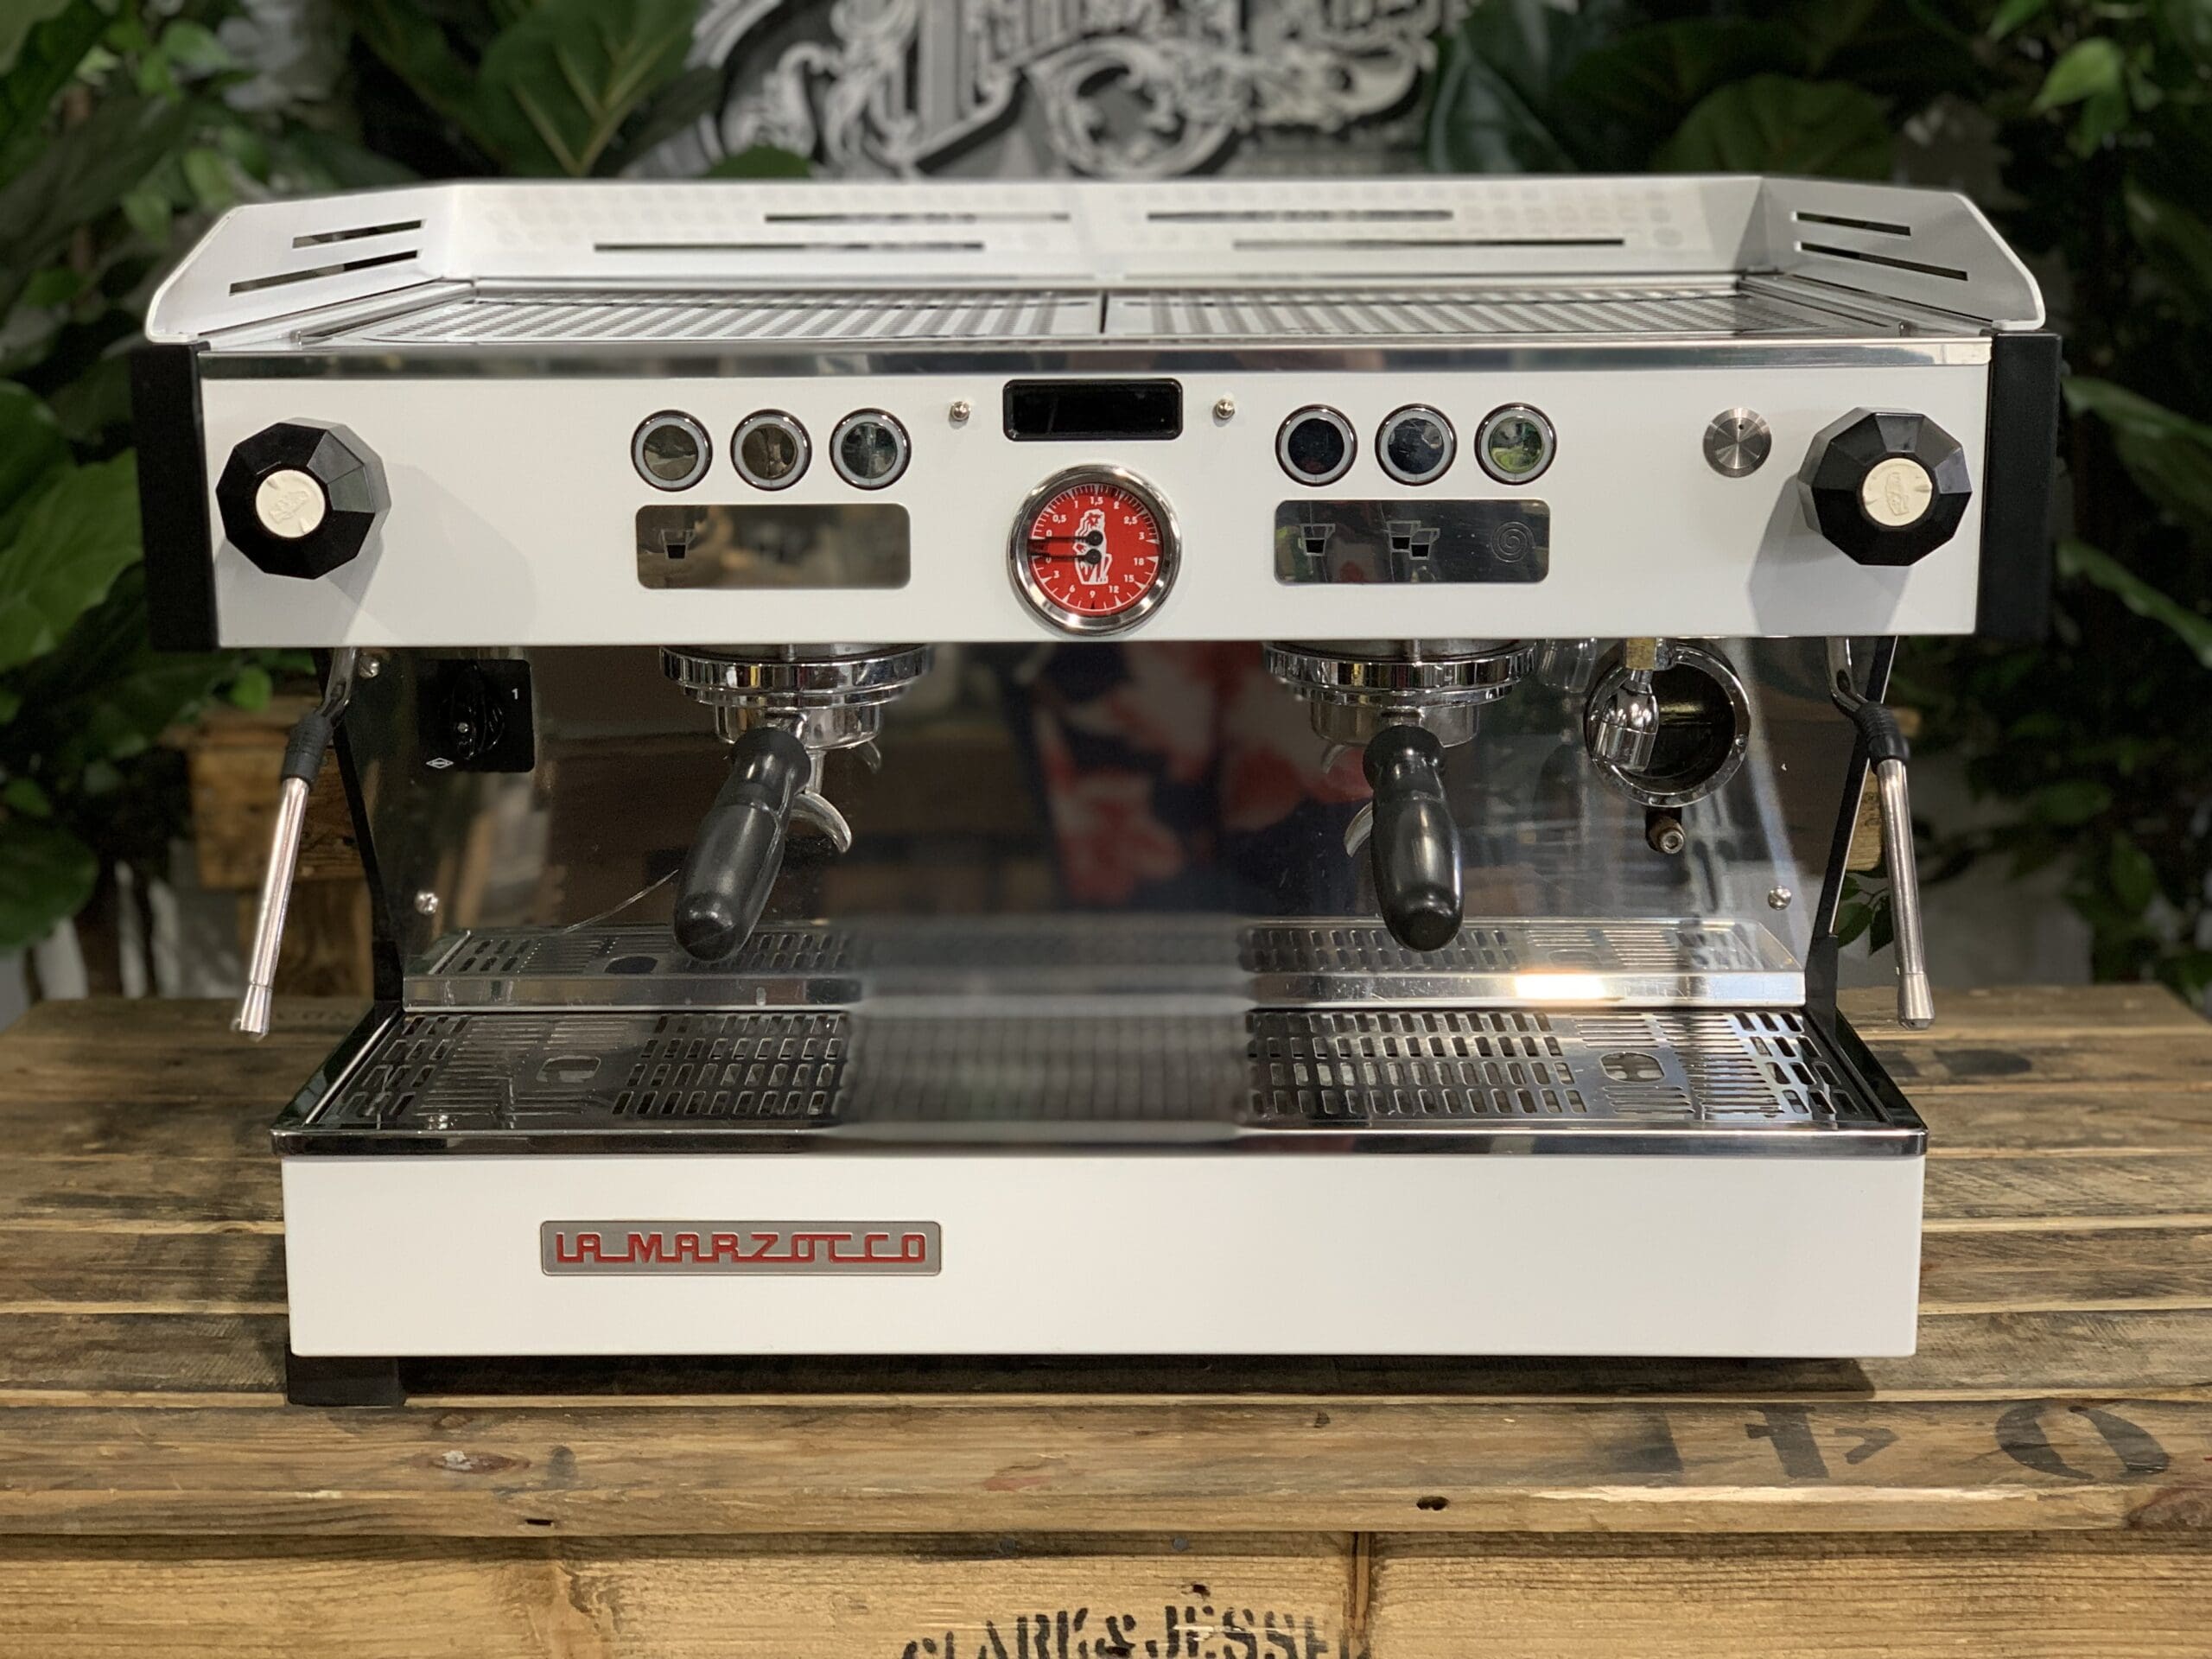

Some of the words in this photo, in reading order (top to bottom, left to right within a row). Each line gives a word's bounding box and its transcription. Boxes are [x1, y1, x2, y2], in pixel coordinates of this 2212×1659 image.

[1074, 500, 1078, 509] 1
[1090, 496, 1103, 506] 1,5
[1052, 514, 1067, 524] 0,5
[1123, 516, 1138, 525] 2,5
[1139, 531, 1145, 540] 3
[1134, 557, 1145, 566] 18
[1069, 584, 1076, 593] 6
[1109, 585, 1120, 594] 12
[1090, 590, 1096, 599] 9
[512, 688, 518, 700] 1
[556, 1232, 601, 1263] LA
[627, 1232, 926, 1264] MARZOCCO
